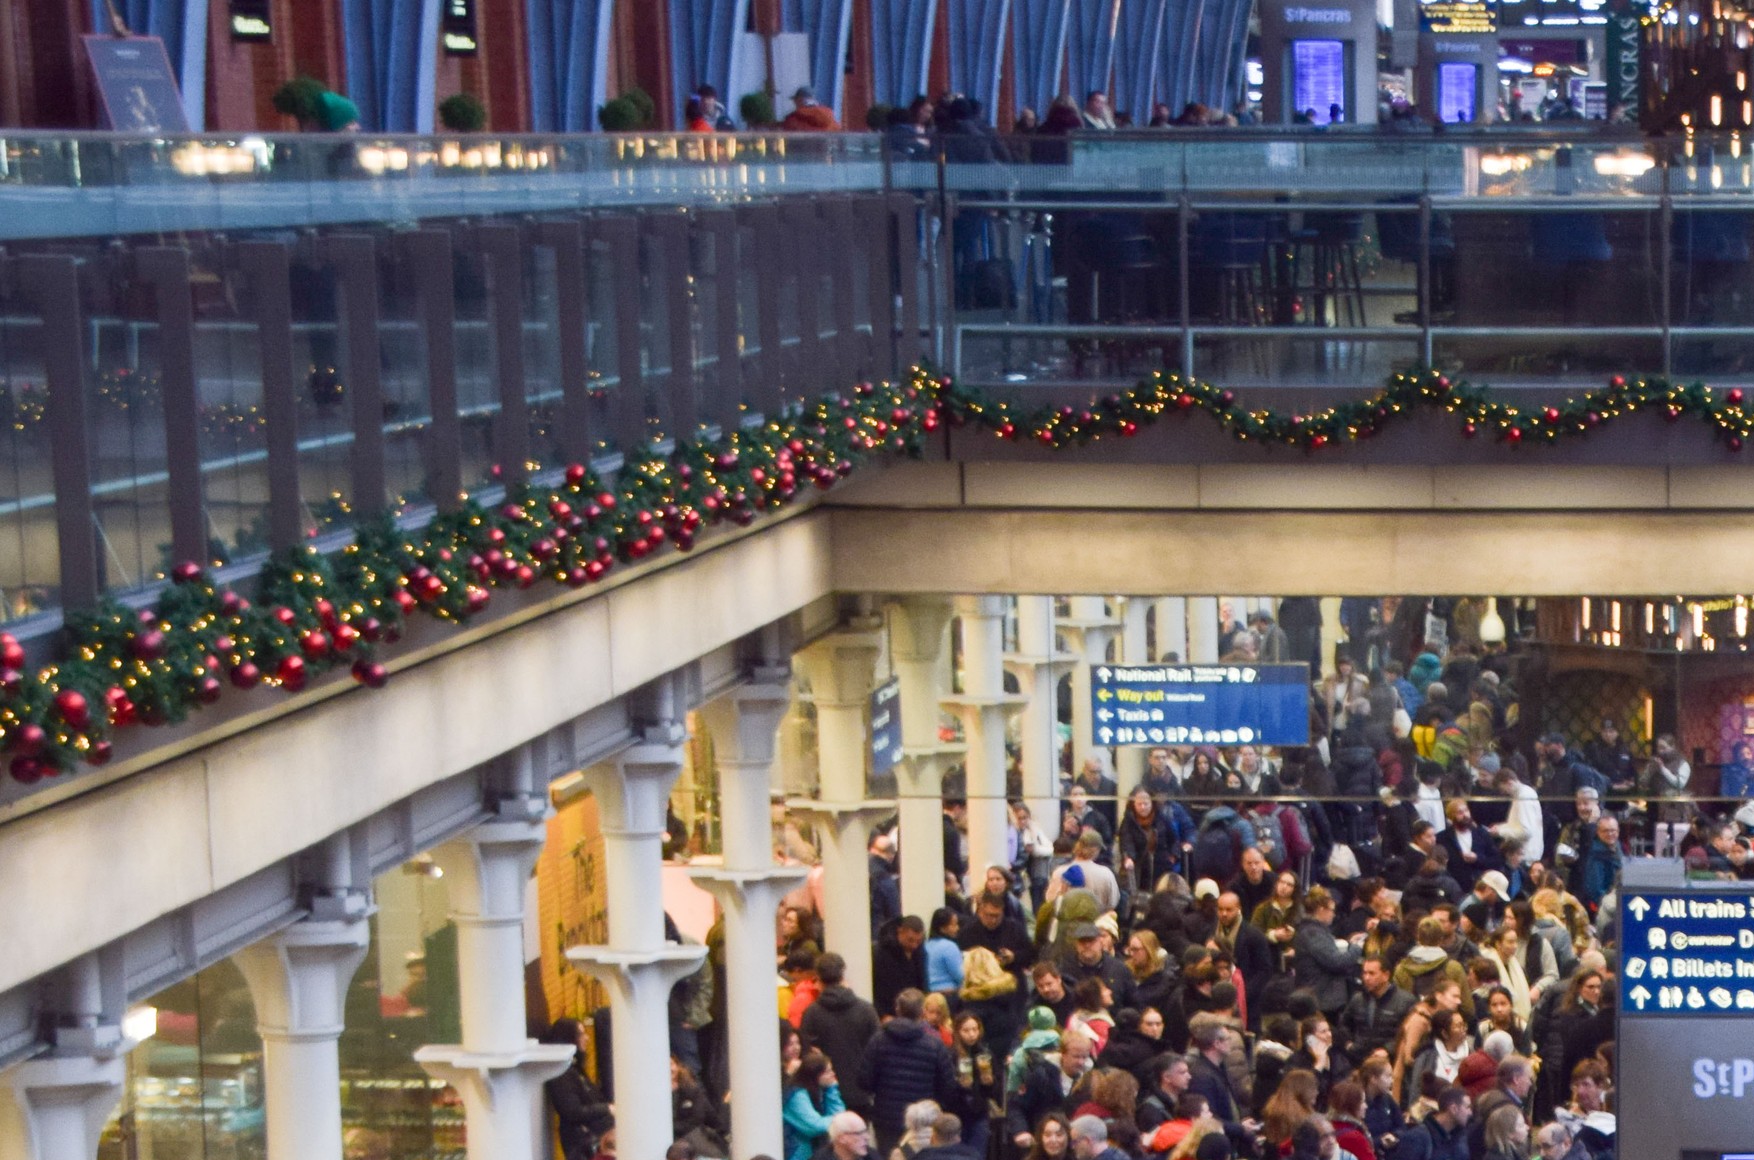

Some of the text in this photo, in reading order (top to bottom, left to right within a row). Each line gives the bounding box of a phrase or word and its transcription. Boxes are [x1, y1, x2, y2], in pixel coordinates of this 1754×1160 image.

[1115, 668, 1192, 682] National Rail
[1116, 688, 1165, 704] Way out
[1116, 708, 1150, 722] Taxis
[1658, 898, 1746, 919] All trains
[1671, 957, 1733, 979] Billets
